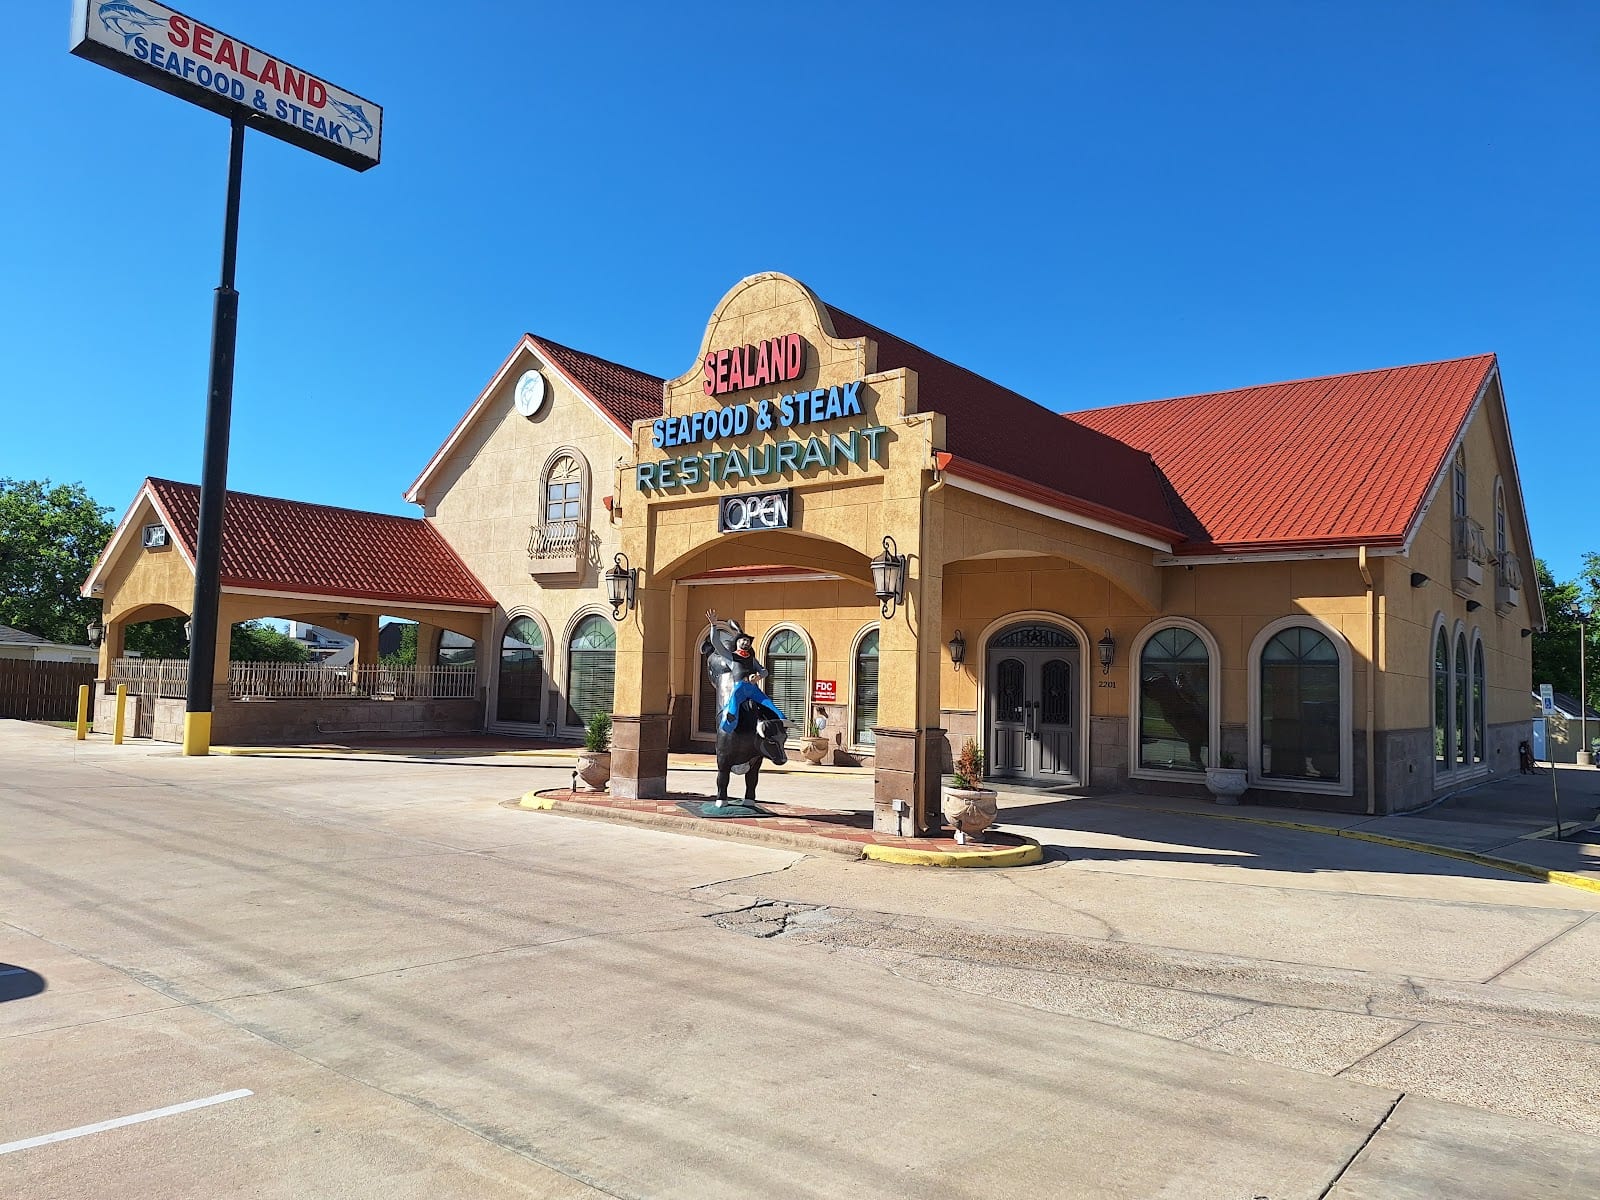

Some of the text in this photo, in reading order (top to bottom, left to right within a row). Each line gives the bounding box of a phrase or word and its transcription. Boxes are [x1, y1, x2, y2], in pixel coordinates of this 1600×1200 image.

[133, 36, 342, 143] SEAFOOD & STEAK
[167, 15, 327, 109] SEALAND
[703, 333, 802, 396] SEALAND
[652, 381, 862, 448] SEAFOOD & STEAK
[636, 425, 887, 491] RESTAURANT
[724, 494, 788, 530] OPEN
[815, 681, 833, 691] FDC
[1098, 681, 1117, 689] 2201
